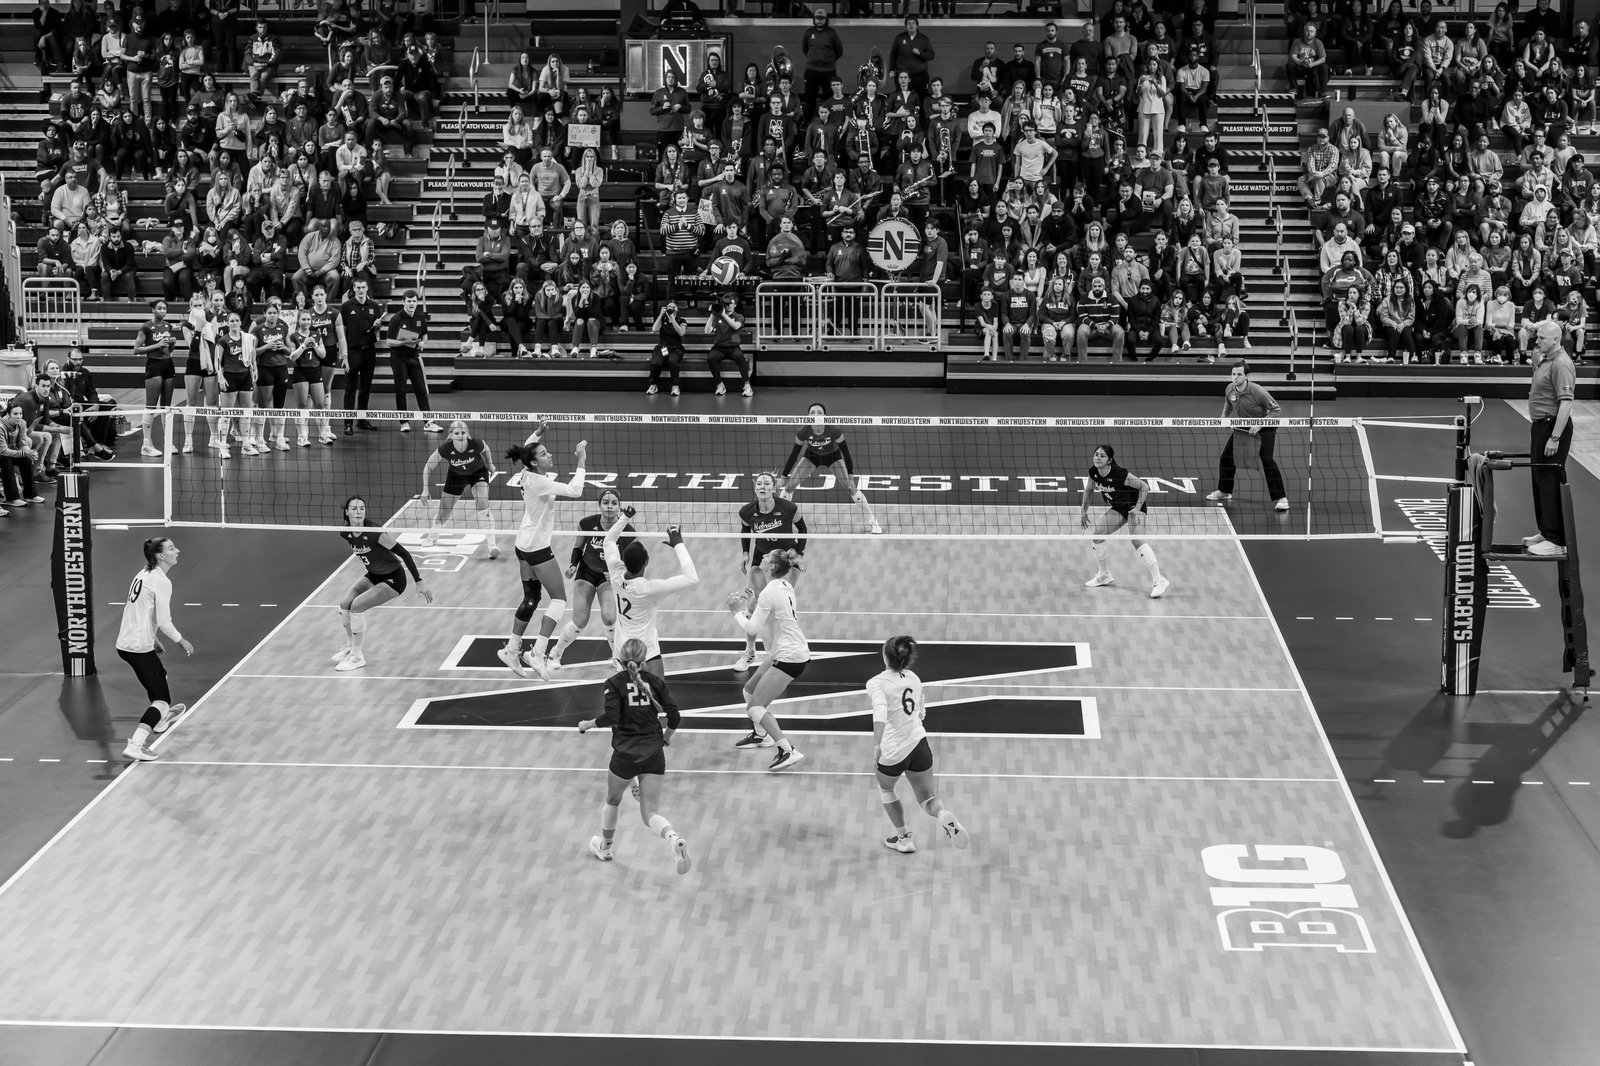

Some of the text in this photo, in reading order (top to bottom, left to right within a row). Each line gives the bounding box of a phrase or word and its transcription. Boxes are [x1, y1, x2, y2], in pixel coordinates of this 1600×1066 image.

[883, 230, 904, 260] N
[307, 350, 313, 360] 7
[252, 409, 301, 418] NORTHWESTERN
[422, 412, 471, 420] NORTHWESTERN
[479, 413, 529, 421] NORTHWESTERN
[593, 415, 643, 423] NORTHWESTERN
[708, 416, 758, 424] NORTHWESTERN
[823, 417, 873, 425] NORTHWESTERN
[881, 417, 931, 425] NORTHWESTERN
[997, 418, 1047, 426] NORTHWESTERN
[1055, 418, 1105, 426] NORTHWESTERN
[753, 519, 783, 533] Nebraska
[62, 501, 88, 654] NORTHWESTERN
[1453, 543, 1476, 642] WILDCATS
[616, 593, 632, 620] 12
[901, 688, 915, 716] 6
